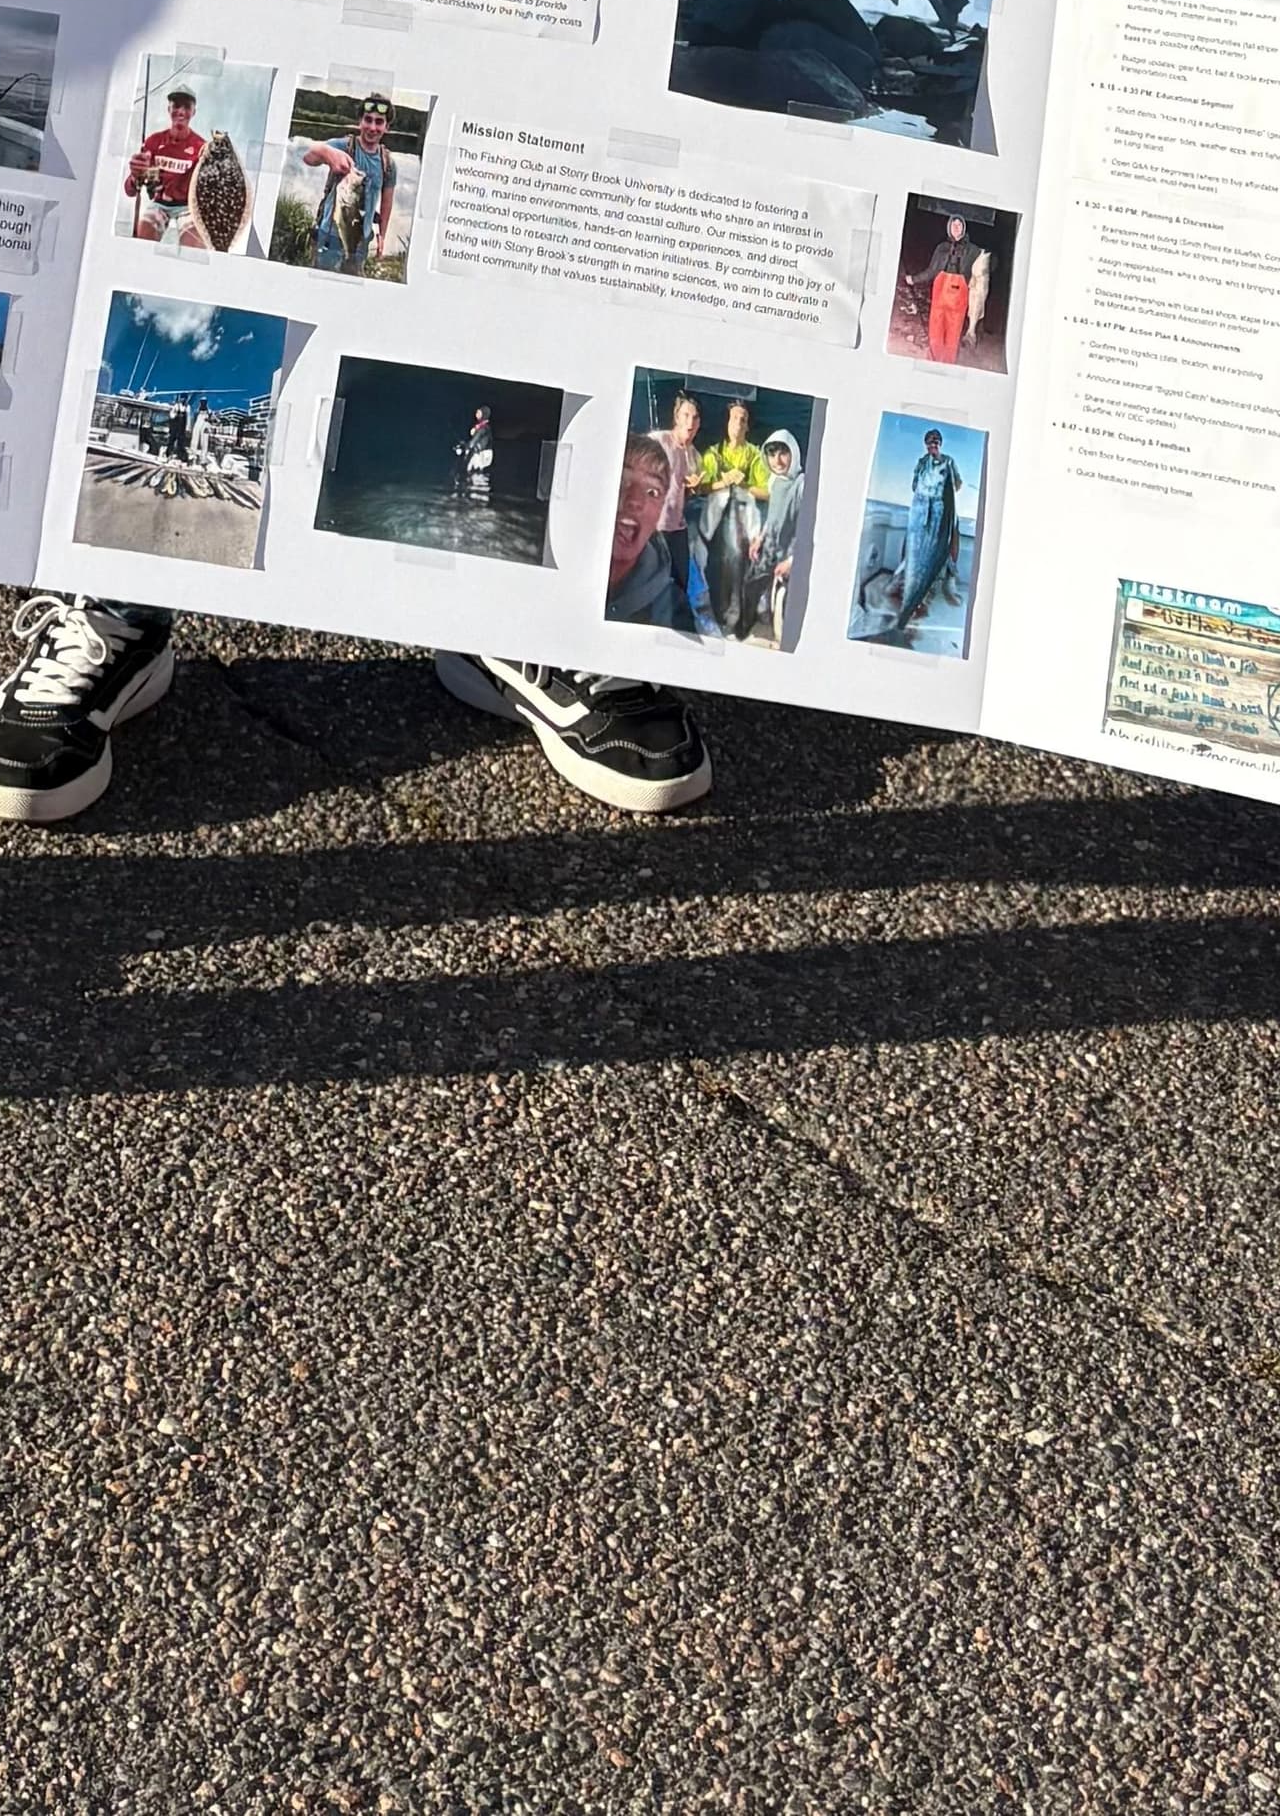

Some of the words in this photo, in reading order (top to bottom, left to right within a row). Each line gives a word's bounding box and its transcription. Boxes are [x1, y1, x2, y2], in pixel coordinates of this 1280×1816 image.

[461, 121, 514, 141] Mission
[517, 131, 585, 154] Statement
[458, 146, 478, 161] The
[480, 151, 518, 170] Fishing
[519, 158, 544, 172] Club
[546, 164, 557, 175] at
[558, 165, 589, 182] Stony
[591, 170, 621, 186] Brook
[624, 176, 675, 198] University
[677, 187, 686, 198] is
[688, 189, 740, 207] dedicated
[741, 198, 752, 209] to
[754, 200, 799, 220] fostering
[801, 211, 808, 220] a
